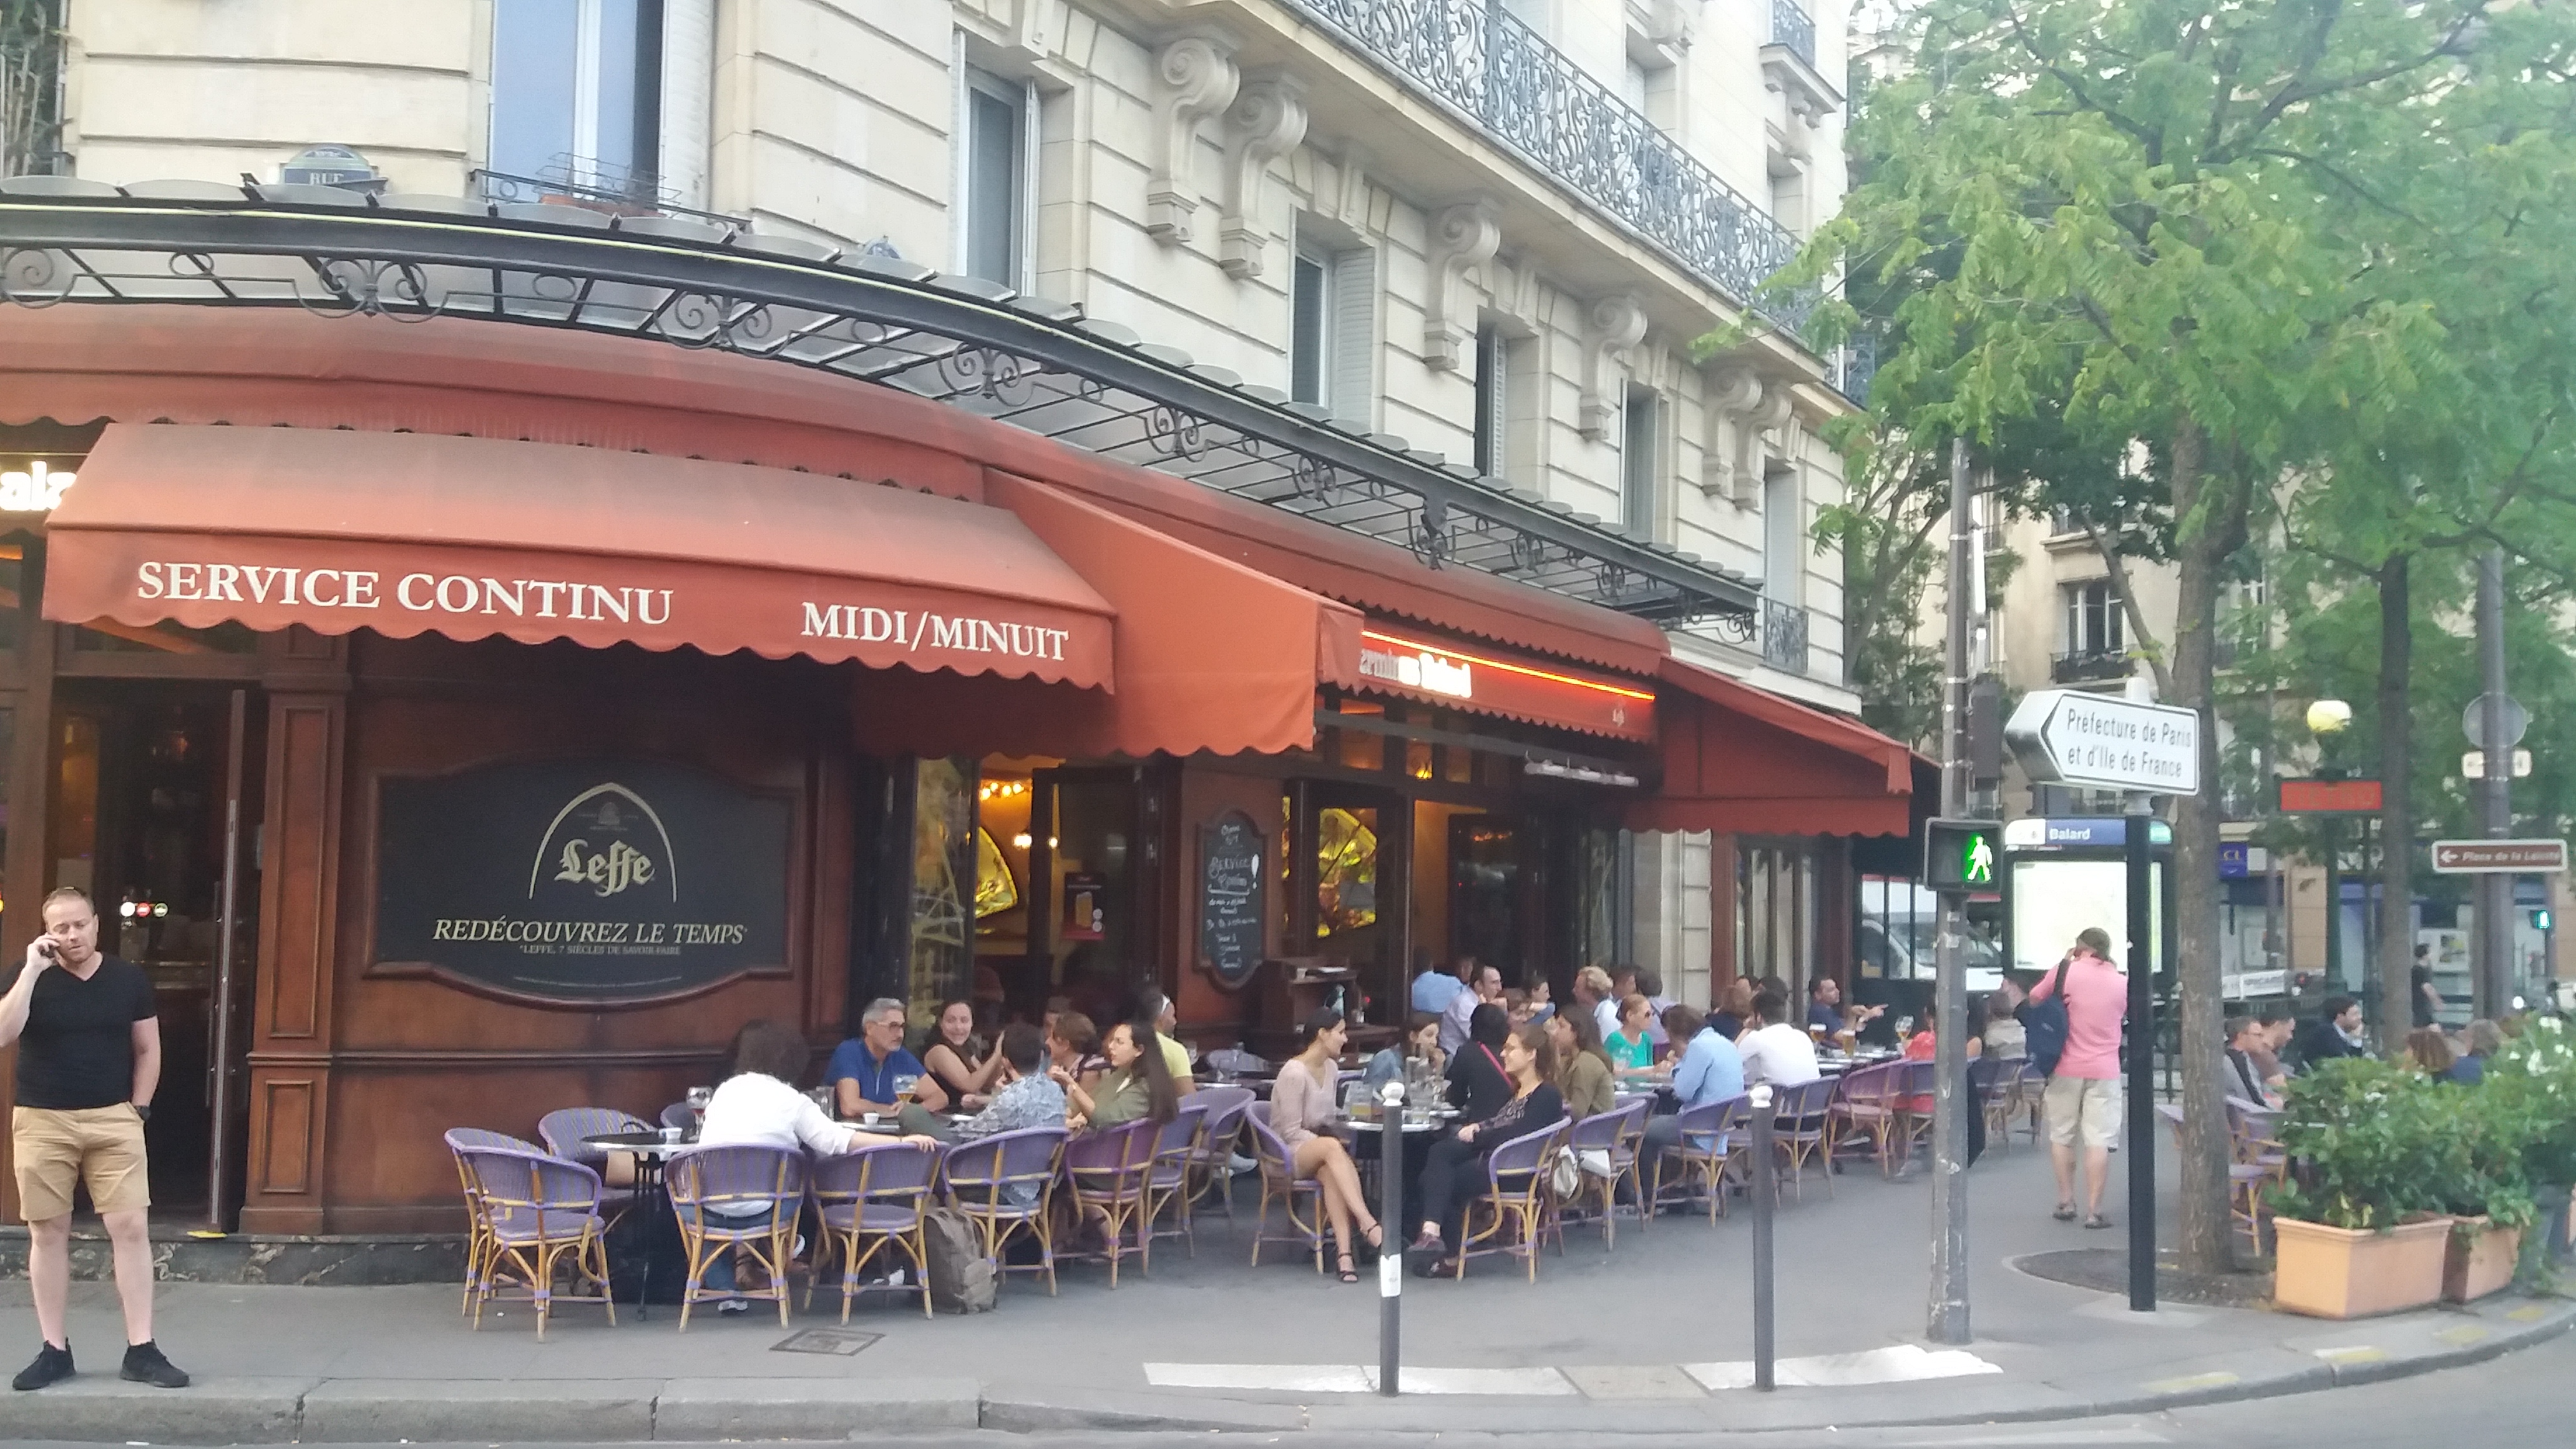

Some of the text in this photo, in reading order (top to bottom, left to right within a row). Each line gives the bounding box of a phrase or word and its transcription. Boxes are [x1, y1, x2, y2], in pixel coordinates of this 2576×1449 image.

[137, 561, 673, 625] SERVICE CONTINU
[801, 602, 1070, 661] MIDI/MINUIT
[2067, 708, 2192, 748] Préfecture de Paris
[2068, 746, 2081, 765] et
[2122, 750, 2135, 772] de
[2142, 751, 2182, 778] France
[2049, 828, 2091, 841] Balard
[555, 839, 655, 897] Leffe
[2495, 852, 2509, 861] de
[433, 915, 629, 943] REDÉCOUVREZ
[635, 923, 665, 944] LE
